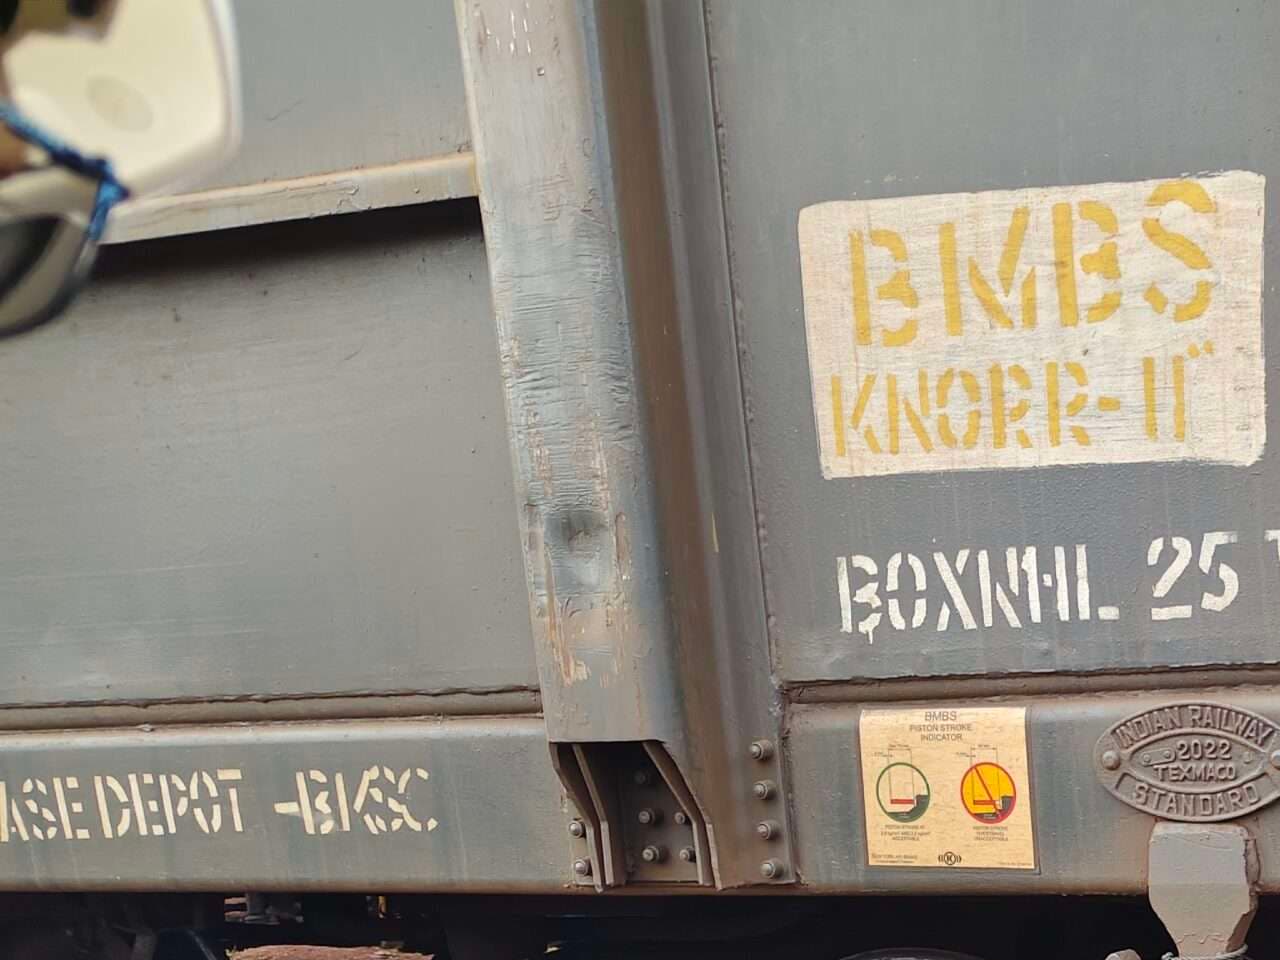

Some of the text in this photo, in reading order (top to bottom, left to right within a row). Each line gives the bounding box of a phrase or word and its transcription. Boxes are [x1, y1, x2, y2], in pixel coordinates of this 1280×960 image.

[849, 179, 1218, 347] BMBS
[1147, 531, 1239, 621] 25
[925, 711, 957, 721] BMBS
[921, 733, 963, 741] INDICATOR
[940, 723, 973, 731] STROKE
[1116, 706, 1273, 748] INDIAN RAILWAY
[1176, 739, 1232, 760] 2022
[1153, 764, 1236, 782] TEXMACO
[1133, 783, 1261, 816] STANDARD
